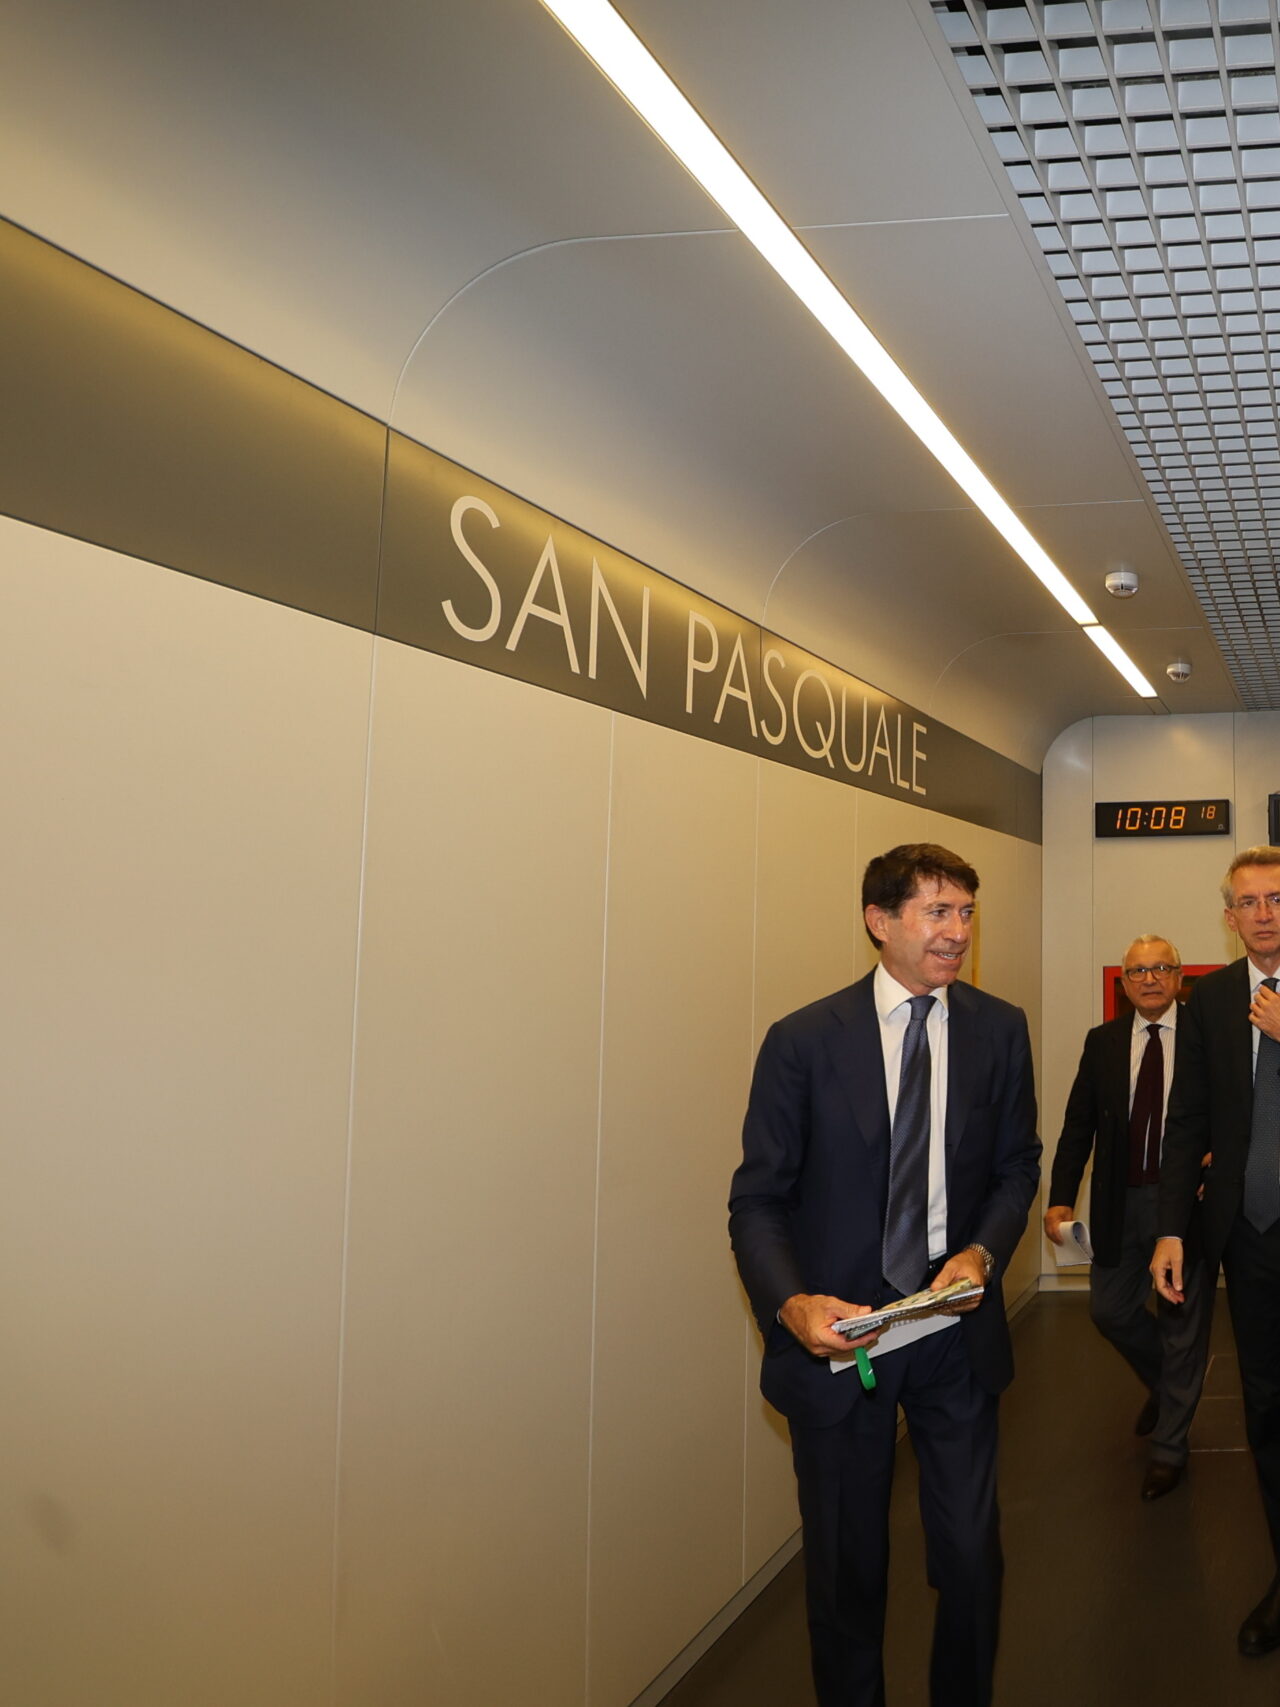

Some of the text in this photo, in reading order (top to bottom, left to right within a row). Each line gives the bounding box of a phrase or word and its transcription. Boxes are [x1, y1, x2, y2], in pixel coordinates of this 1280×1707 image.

[441, 495, 927, 796] SAN PASQUALE
[1116, 805, 1216, 830] 10:08 18
